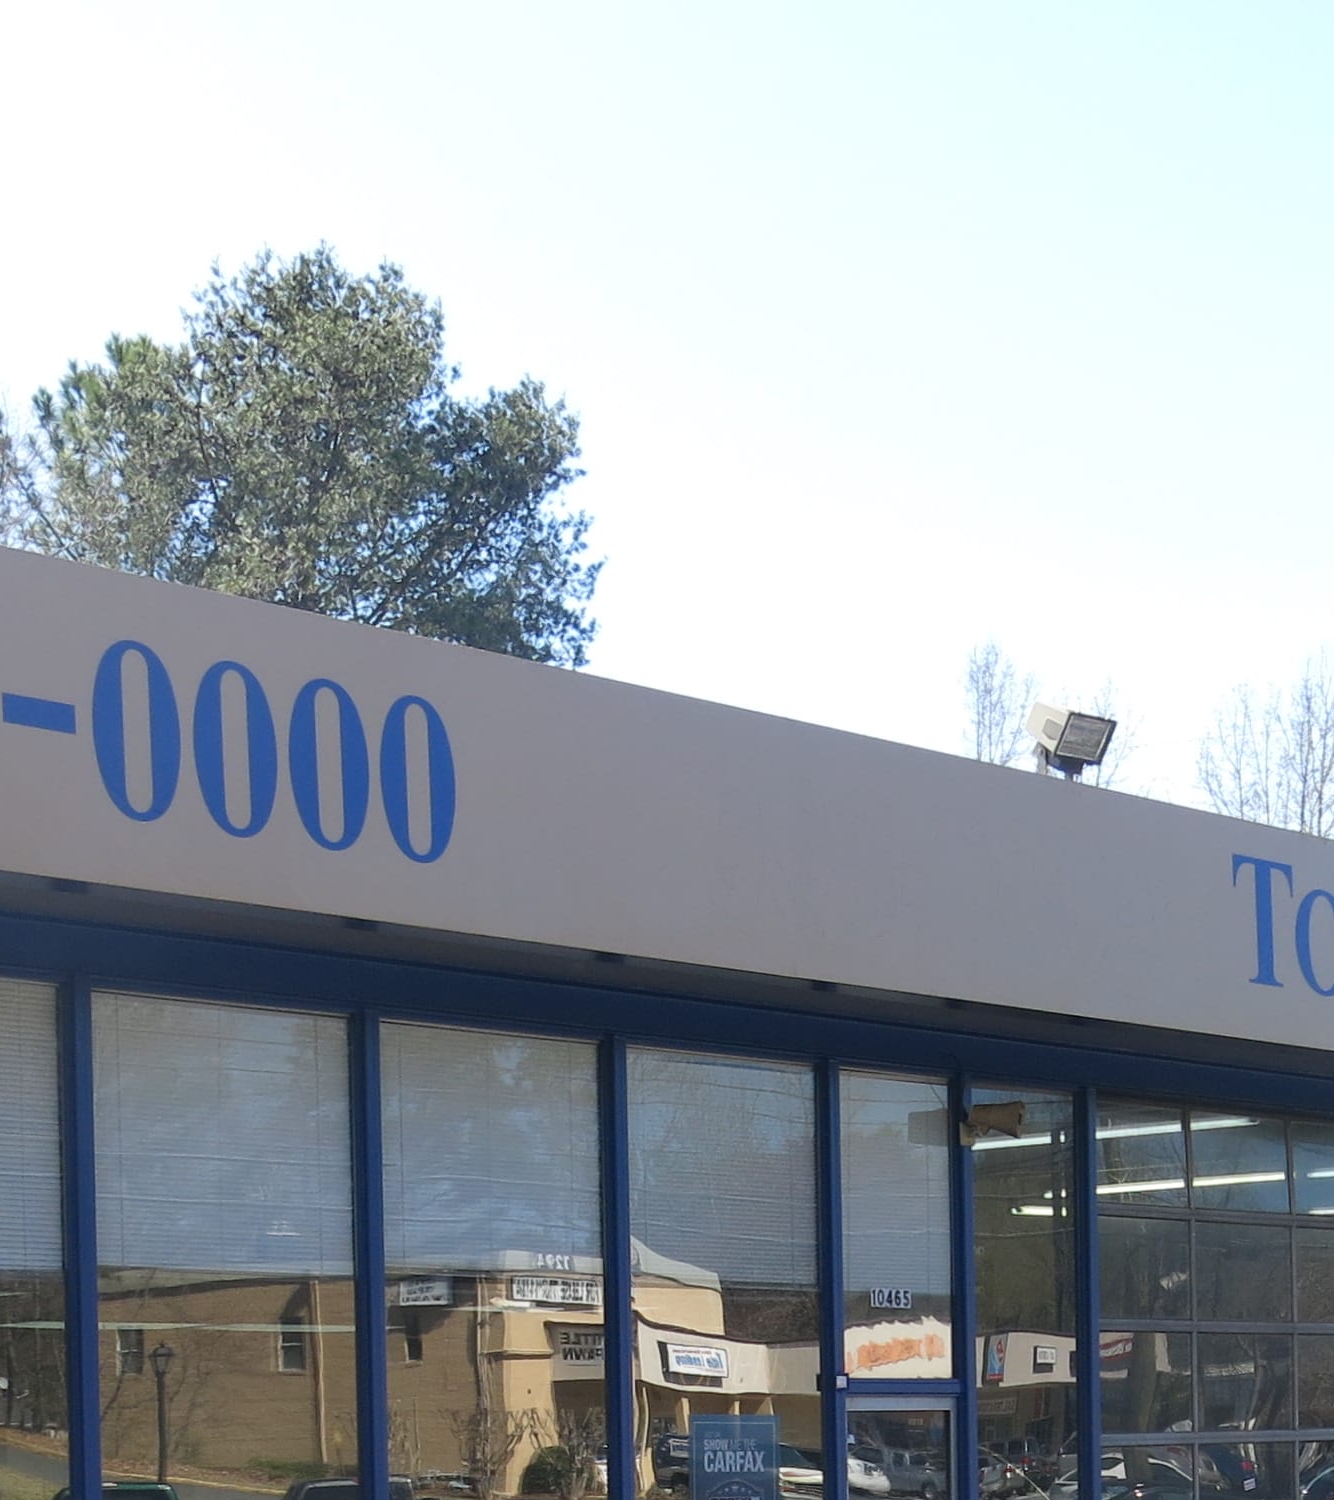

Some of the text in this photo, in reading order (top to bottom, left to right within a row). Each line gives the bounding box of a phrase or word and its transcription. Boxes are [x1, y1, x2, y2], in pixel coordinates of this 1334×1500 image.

[871, 1289, 911, 1307] 10465
[704, 1439, 728, 1451] SHOW
[704, 1450, 764, 1473] CARFAX
